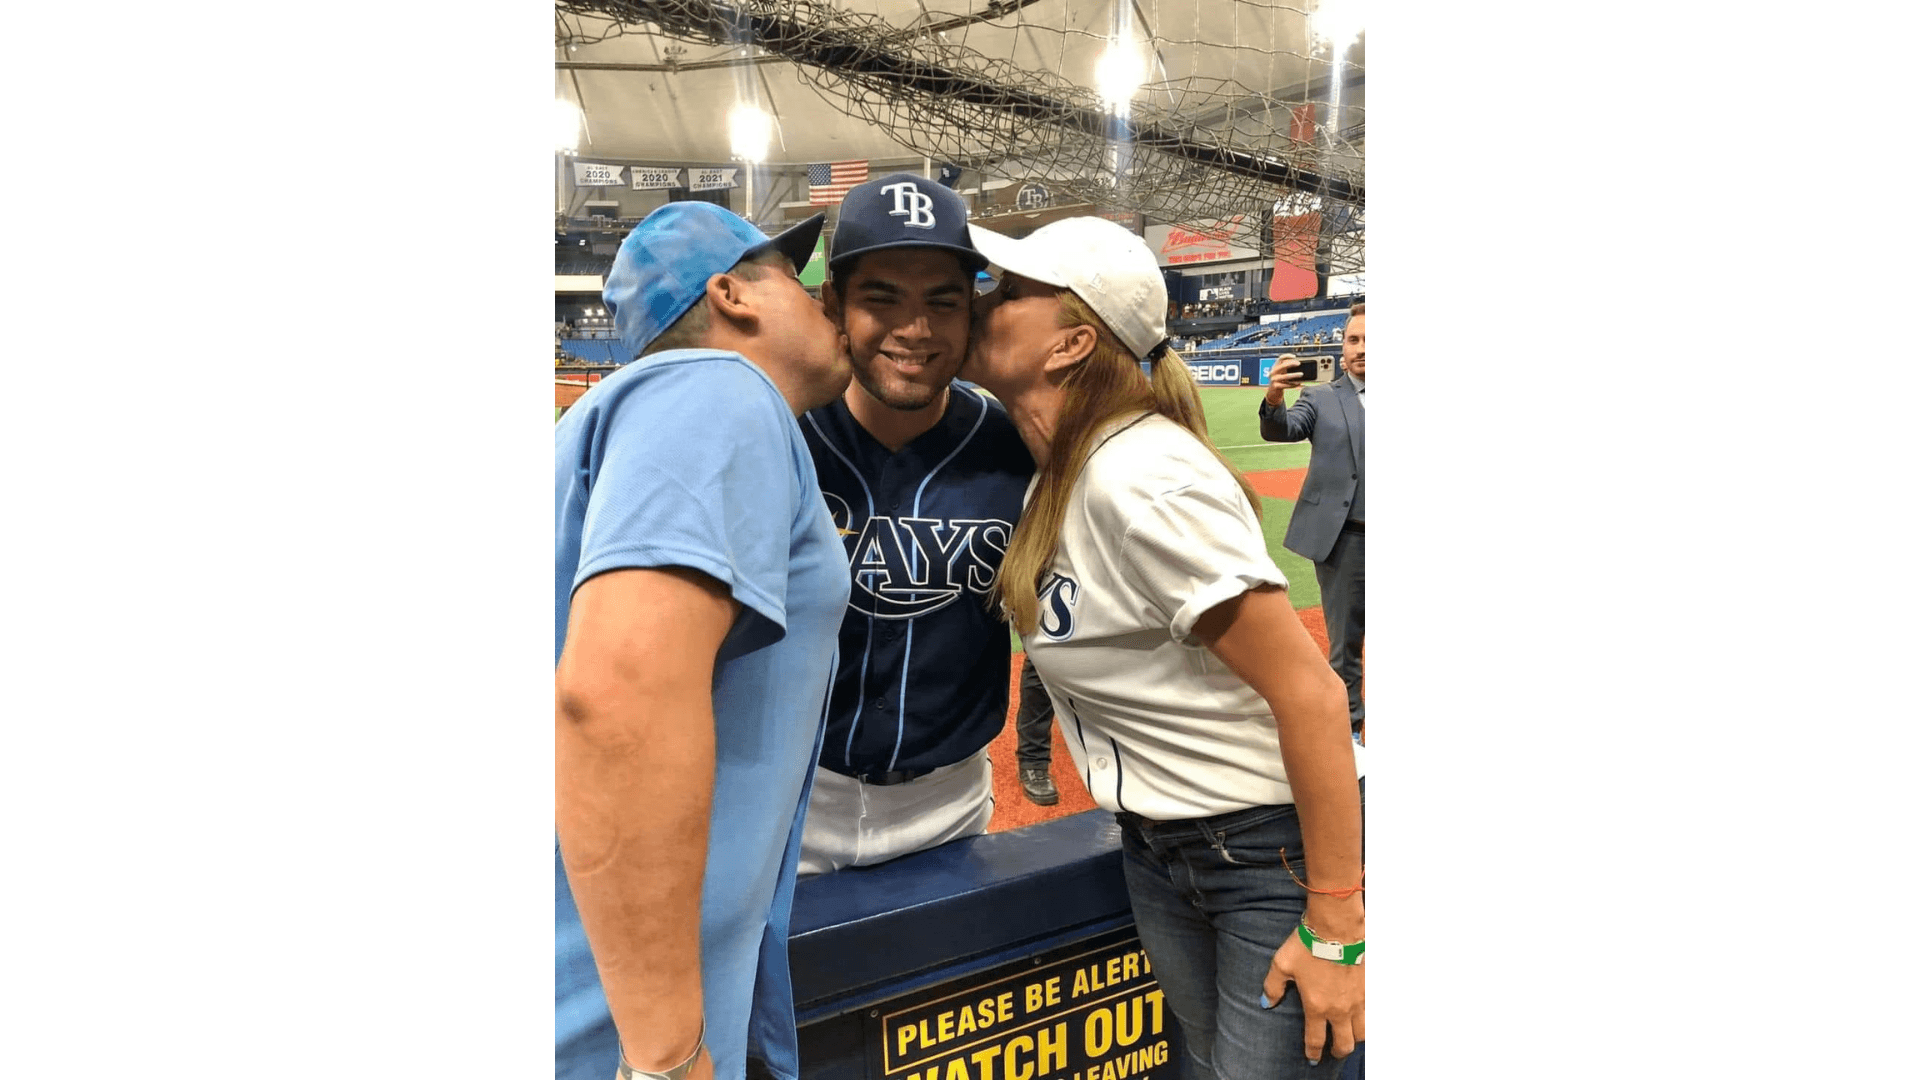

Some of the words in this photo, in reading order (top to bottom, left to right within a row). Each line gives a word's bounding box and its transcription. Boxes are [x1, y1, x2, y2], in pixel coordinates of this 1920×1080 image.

[586, 170, 610, 178] 2020
[642, 173, 668, 181] 2020
[699, 174, 722, 182] 2021
[880, 182, 936, 229] TB
[1189, 365, 1239, 381] GEICO
[897, 990, 1014, 1057] PLEASE
[1025, 976, 1061, 1014] BE
[906, 1021, 1067, 1080] ATCH
[1084, 989, 1166, 1058] OUT
